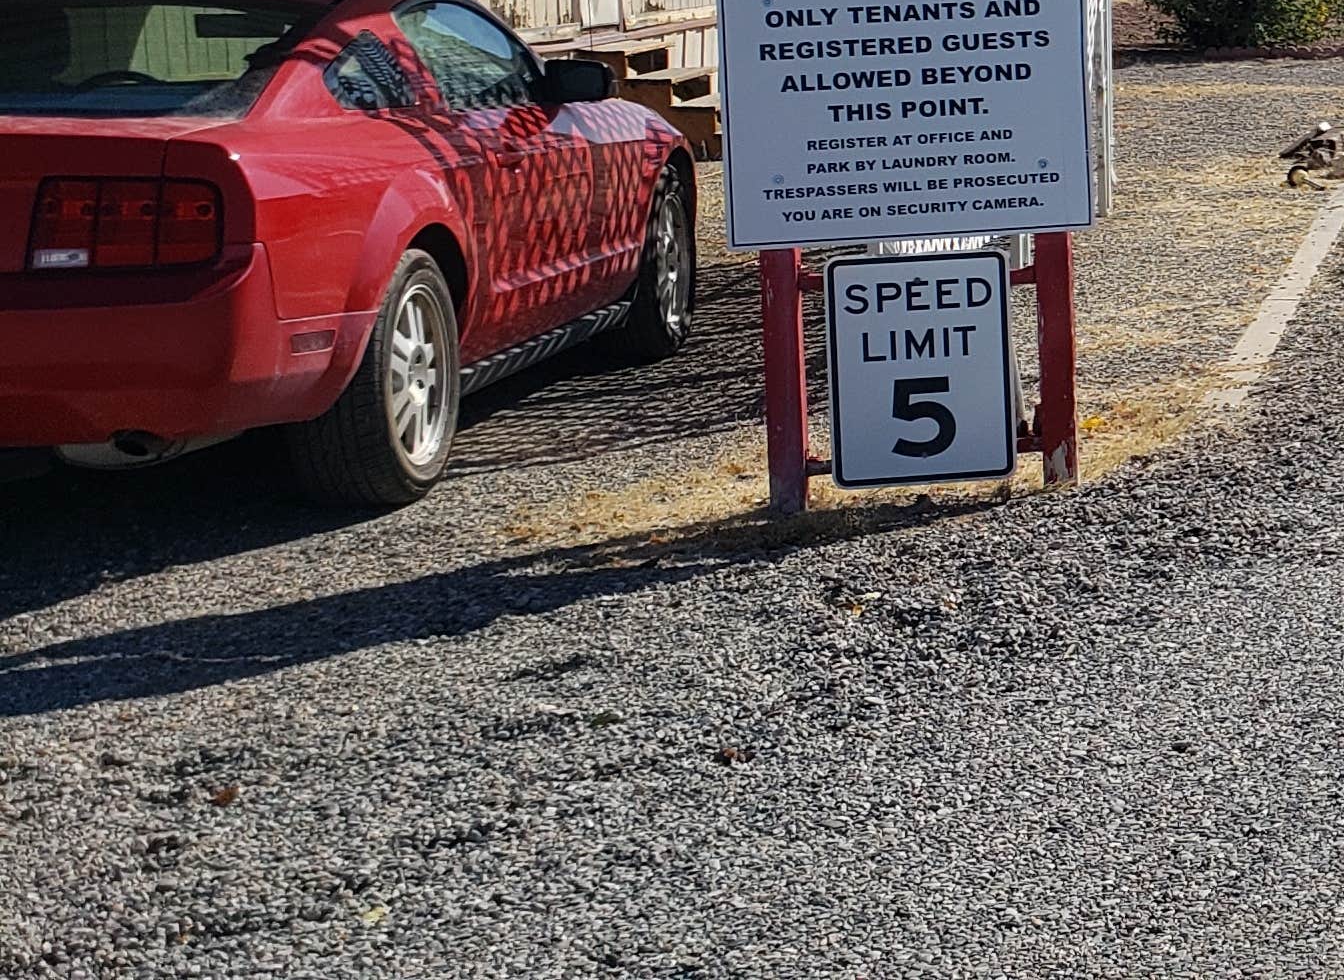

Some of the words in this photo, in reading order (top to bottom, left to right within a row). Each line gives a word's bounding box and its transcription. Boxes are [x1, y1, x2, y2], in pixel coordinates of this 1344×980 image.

[766, 8, 838, 28] ONLY
[847, 2, 975, 23] TENANTS
[985, 0, 1040, 17] AND
[760, 37, 931, 60] REGISTERED
[943, 31, 1049, 51] GUESTS
[781, 70, 911, 92] ALLOWED
[922, 64, 1031, 84] BEYOND
[828, 103, 891, 122] THIS
[902, 98, 988, 118] POINT.
[806, 136, 888, 151] REGISTER
[892, 134, 913, 147] AT
[917, 131, 976, 145] OFFICE
[979, 129, 1013, 141] AND
[807, 161, 851, 175] PARK
[855, 159, 877, 172] BY
[881, 155, 958, 170] LAUNDRY
[963, 152, 1016, 165] ROOM.
[762, 183, 878, 201] TRESPASSERS
[882, 180, 923, 193] WILL
[927, 178, 949, 191] BE
[953, 172, 1060, 189] PROSECUTED
[781, 210, 816, 223] YOU
[820, 207, 854, 221] ARE
[858, 205, 882, 218] ON
[886, 200, 969, 216] SECURITY
[971, 196, 1045, 211] CAMERA.
[844, 277, 991, 314] SPEED
[862, 326, 976, 362] LIMIT
[892, 376, 956, 458] 5
